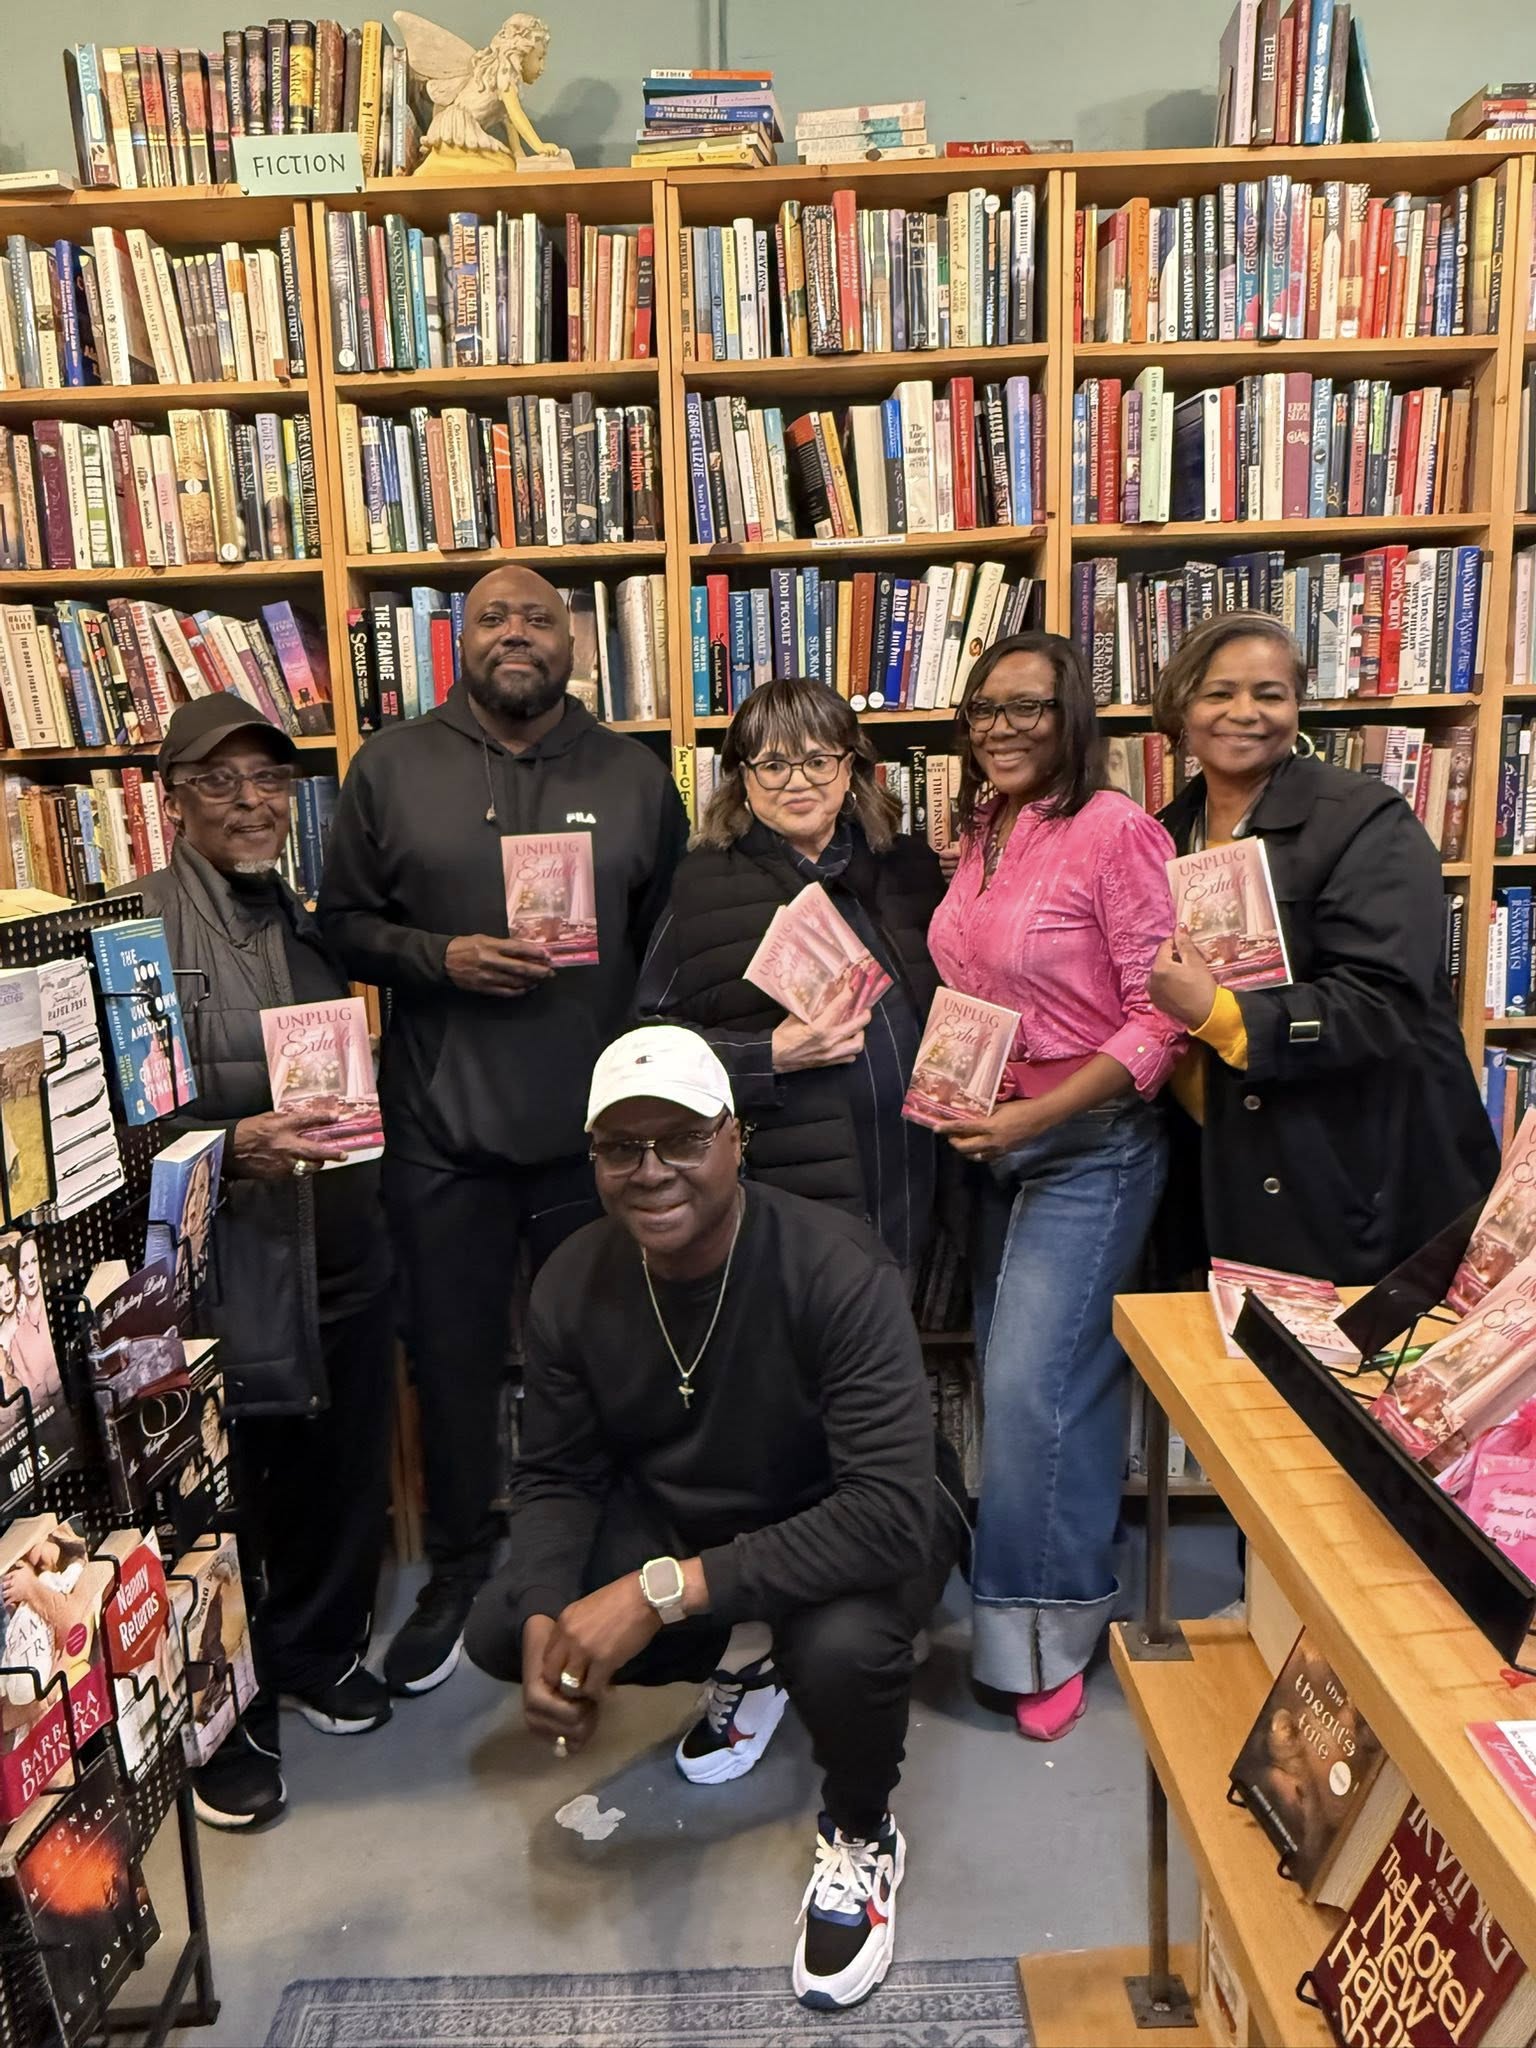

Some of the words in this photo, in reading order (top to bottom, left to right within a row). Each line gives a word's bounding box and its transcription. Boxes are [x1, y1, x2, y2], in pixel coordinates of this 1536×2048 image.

[80, 52, 93, 91] OATES
[290, 54, 301, 98] MARK
[1262, 33, 1276, 83] TEETH
[229, 57, 243, 116] ARMAGEDDON
[252, 153, 346, 178] FICTION
[971, 143, 987, 154] Art
[1138, 207, 1148, 229] Dear
[1183, 207, 1193, 255] GEORGE
[1205, 206, 1215, 254] GEORGE
[453, 224, 463, 269] COUNTRY
[463, 226, 478, 264] HARD
[1135, 233, 1147, 256] Lucy
[757, 238, 767, 293] SURVIVOR
[466, 275, 478, 326] MICHAEL
[1183, 268, 1193, 329] SAUNDERS
[1204, 267, 1215, 328] SAUNDERS
[1151, 372, 1160, 393] time
[1151, 396, 1160, 406] of
[1317, 384, 1329, 415] WILL
[260, 417, 274, 450] EDDIE'S
[558, 408, 572, 445] Judith
[687, 402, 701, 439] GEORGE
[1148, 409, 1158, 423] my
[1149, 425, 1159, 441] life
[264, 453, 279, 493] BASTARD
[561, 446, 574, 488] Michael
[629, 449, 644, 491] Drifters
[691, 447, 704, 478] LIZZIE
[1104, 459, 1114, 512] ETERNAL
[1313, 474, 1324, 501] BUTT
[778, 571, 790, 597] JODI
[1202, 582, 1212, 602] THE
[119, 616, 129, 630] THE
[374, 604, 391, 628] THE
[734, 596, 745, 618] JODI
[755, 593, 766, 615] JODI
[736, 620, 745, 660] PICOULT
[756, 617, 766, 655] PICOULT
[780, 601, 791, 646] PICOULT
[350, 632, 368, 676] Sexus
[375, 631, 395, 681] CHANGE
[808, 636, 820, 678] STORM
[1102, 632, 1114, 664] GODS
[1102, 667, 1114, 693] AND
[566, 812, 596, 824] FILA
[515, 840, 580, 857] UNPLUG
[1178, 847, 1247, 877] UNPLUG
[120, 949, 138, 969] THE
[760, 923, 794, 976] UNPLUG
[134, 961, 162, 983] BOOK
[277, 1007, 353, 1030] UNPLUG
[943, 998, 1001, 1029] UNPLUG
[115, 1562, 150, 1617] Nanny
[118, 1589, 160, 1652] Returns
[1324, 1680, 1345, 1707] the
[21, 1699, 101, 1802] DELINSKY
[1298, 1713, 1329, 1761] tale
[1380, 1842, 1409, 1904] The
[63, 1904, 150, 2025] BELOVED
[1360, 1888, 1435, 2029] New
[1390, 1873, 1486, 2046] Hotel
